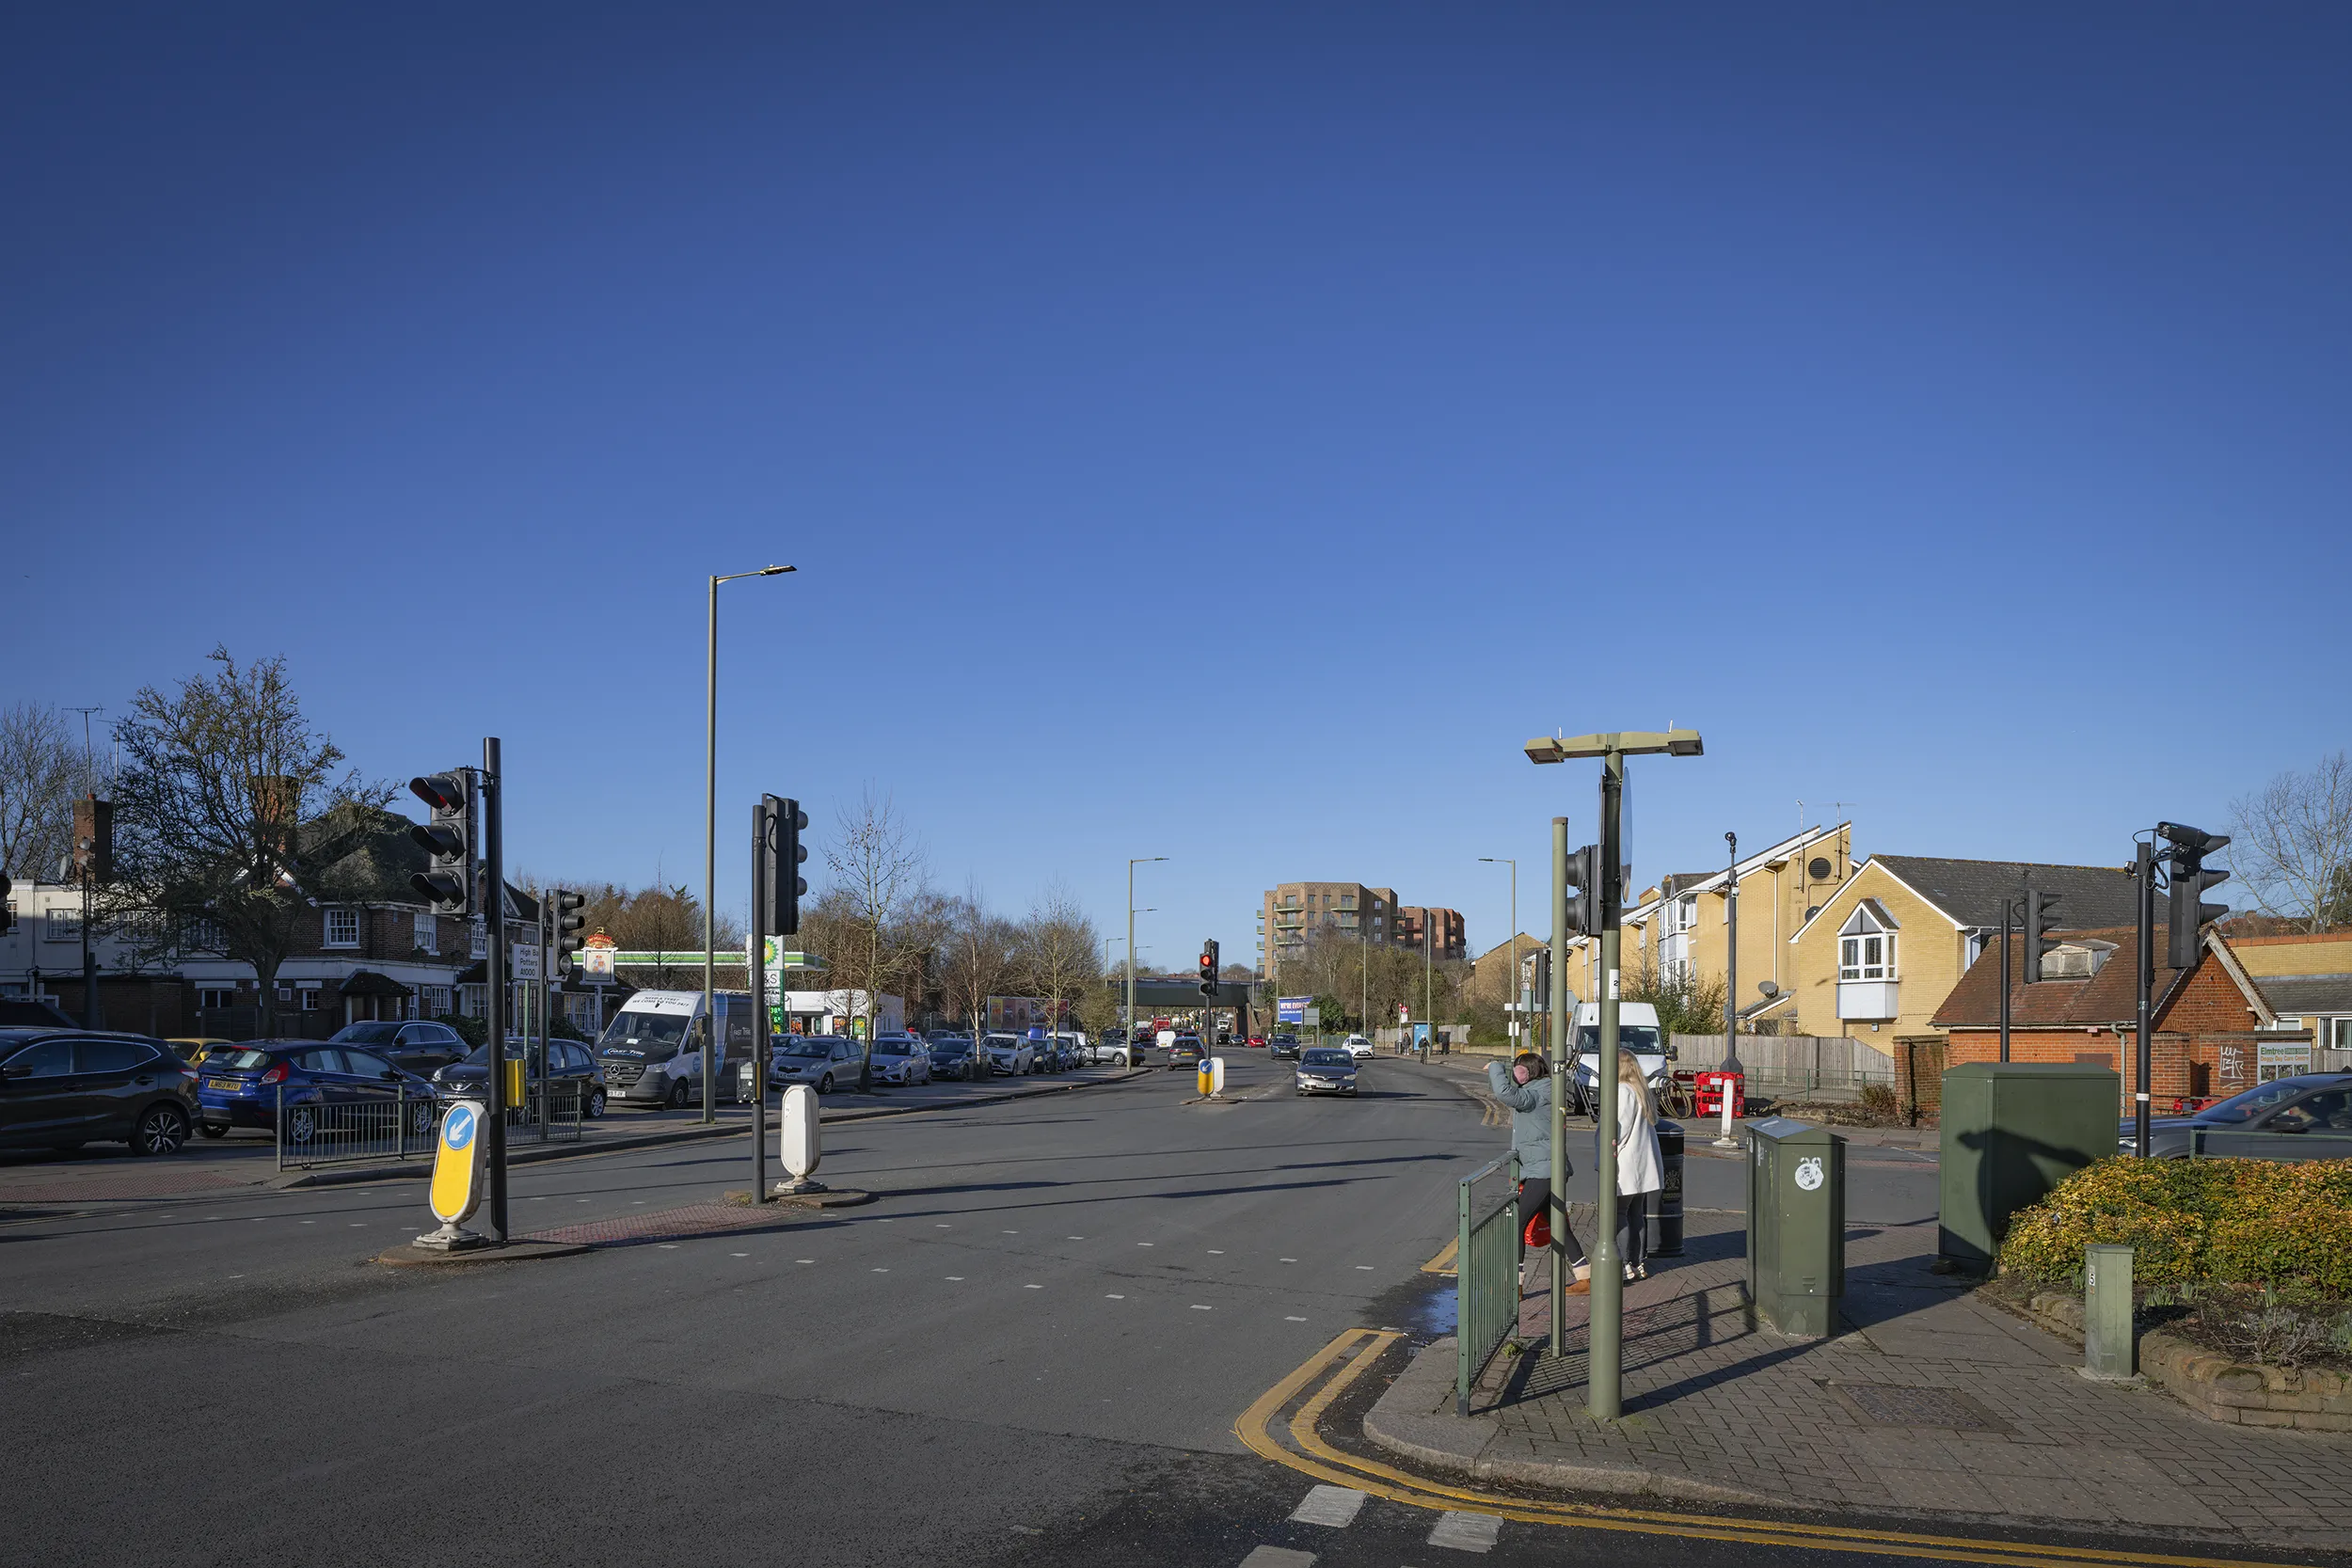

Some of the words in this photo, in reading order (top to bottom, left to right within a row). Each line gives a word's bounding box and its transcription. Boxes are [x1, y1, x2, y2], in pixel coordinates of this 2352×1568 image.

[520, 948, 531, 957] High
[520, 958, 538, 966] Potters
[2090, 1273, 2095, 1284] 5
